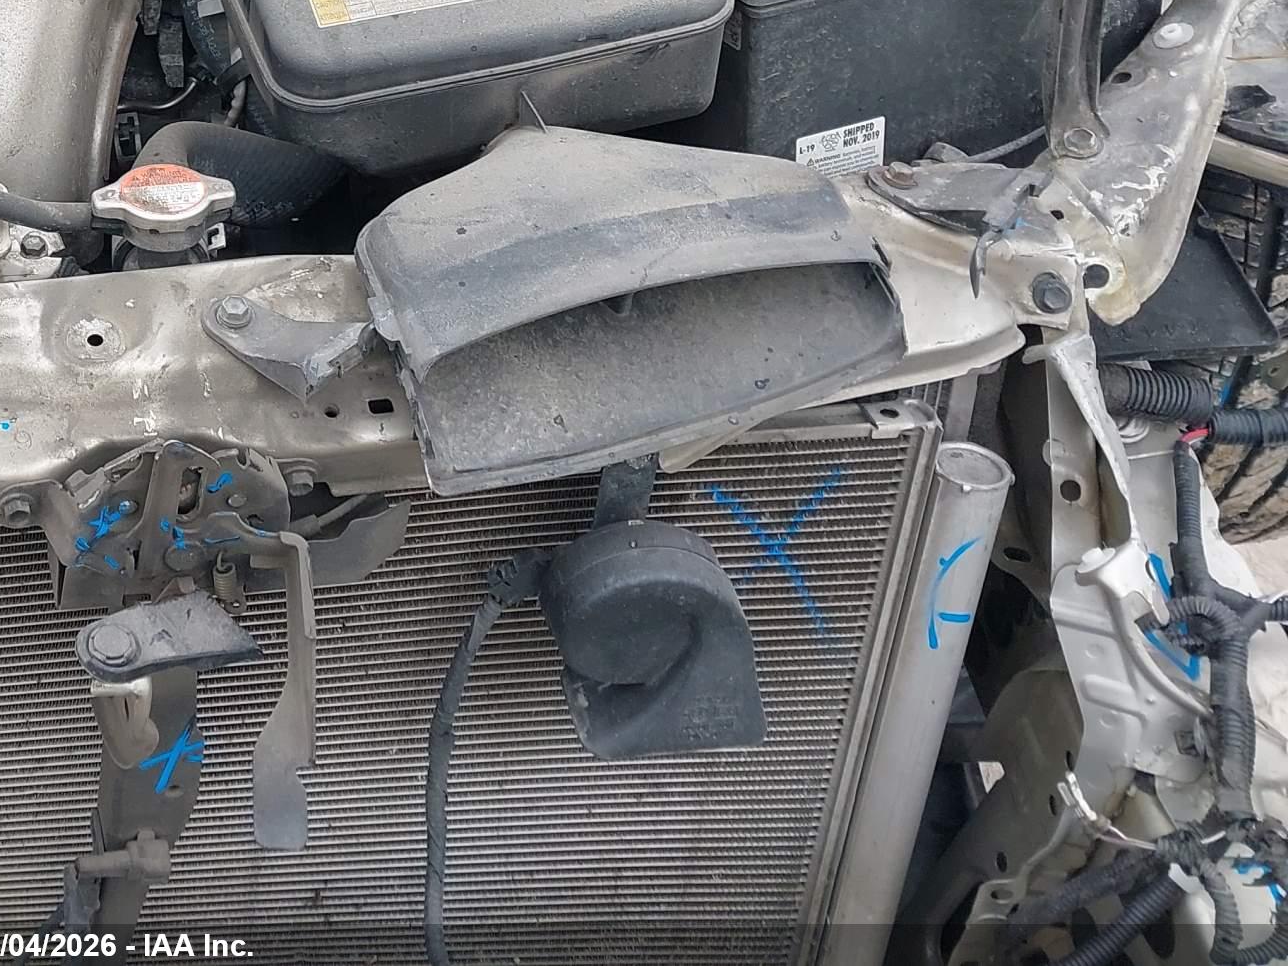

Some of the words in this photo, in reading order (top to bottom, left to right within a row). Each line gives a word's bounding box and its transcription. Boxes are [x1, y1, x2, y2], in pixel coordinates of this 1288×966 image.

[843, 122, 874, 139] SHIPPED
[843, 136, 860, 148] NOV.
[862, 129, 880, 143] 2019
[799, 144, 815, 154] L-19
